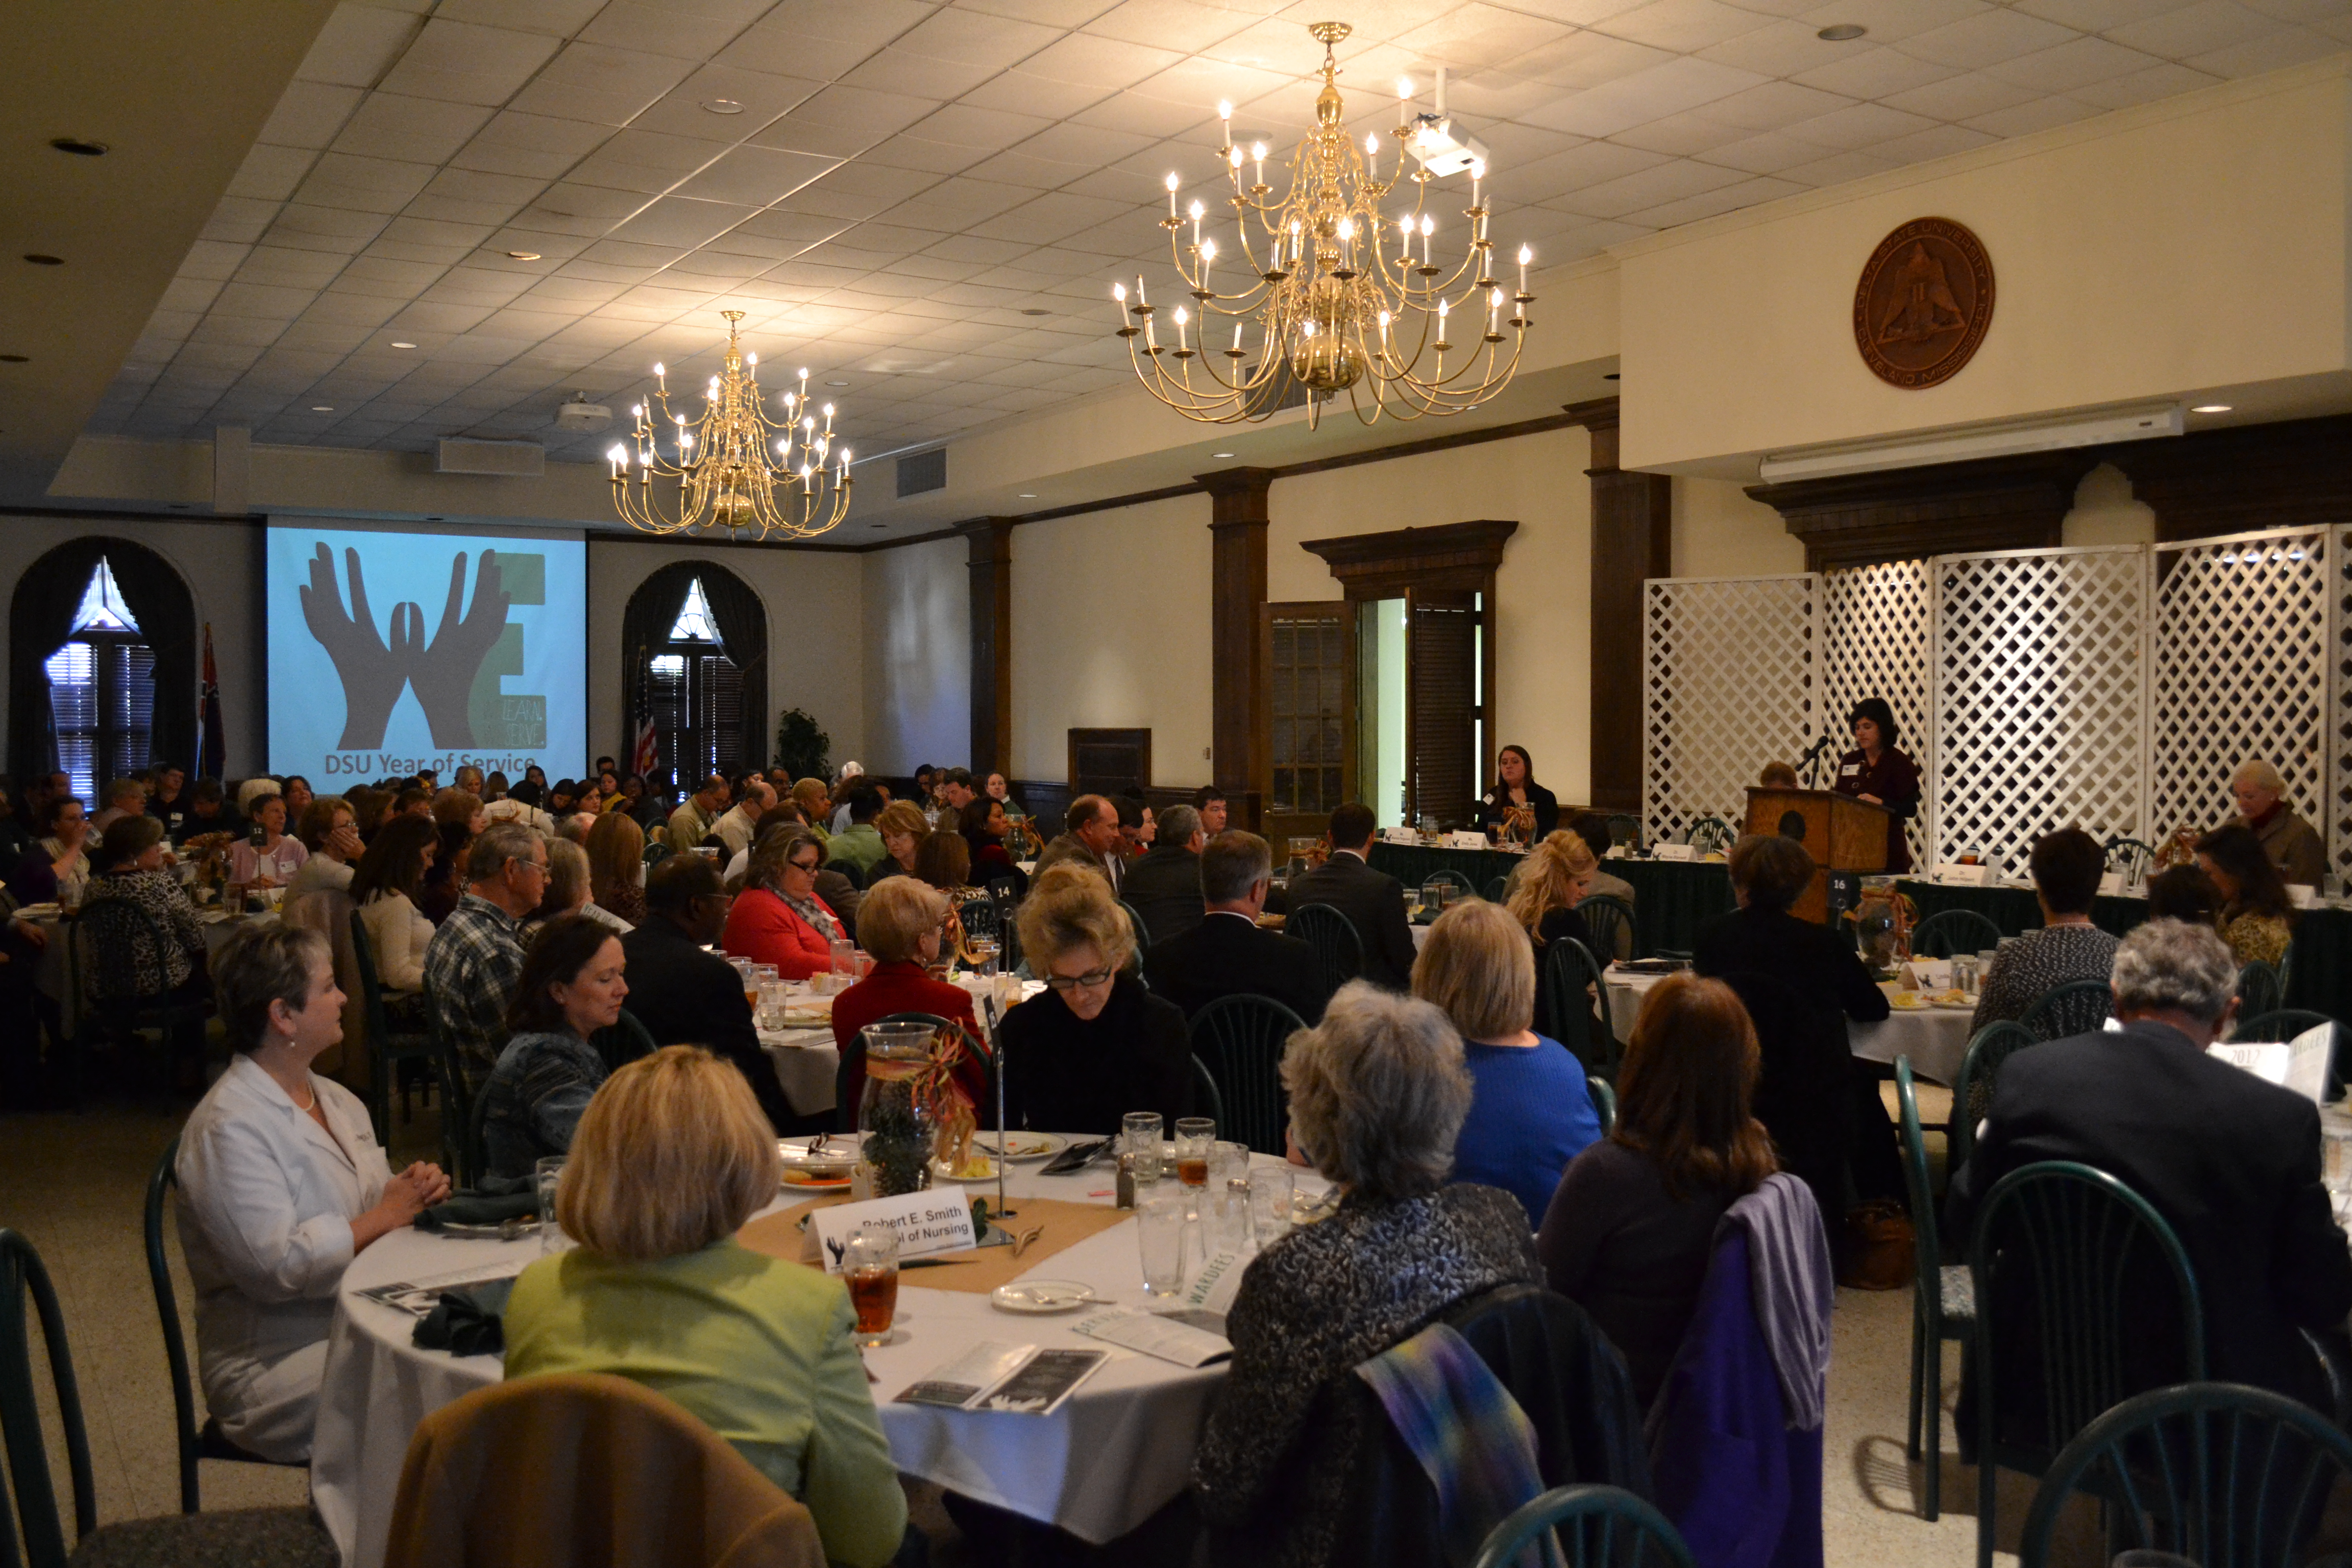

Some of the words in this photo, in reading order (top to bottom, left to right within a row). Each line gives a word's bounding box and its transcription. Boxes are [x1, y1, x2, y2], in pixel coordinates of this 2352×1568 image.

[1857, 260, 1879, 308] DELTA
[1878, 225, 1916, 257] STATE
[1921, 222, 1986, 278] UNIVERSITY
[1922, 304, 1987, 382] MISSISSIPPI
[325, 754, 371, 774] DSU
[379, 754, 425, 773] Year
[433, 753, 454, 773] of
[461, 753, 535, 773] Service
[998, 886, 1010, 898] 14
[1834, 879, 1845, 889] 16
[2231, 1049, 2261, 1064] 2012
[910, 1212, 922, 1224] E.
[925, 1206, 962, 1221] Smith
[909, 1229, 919, 1242] of
[923, 1223, 969, 1238] Nursing
